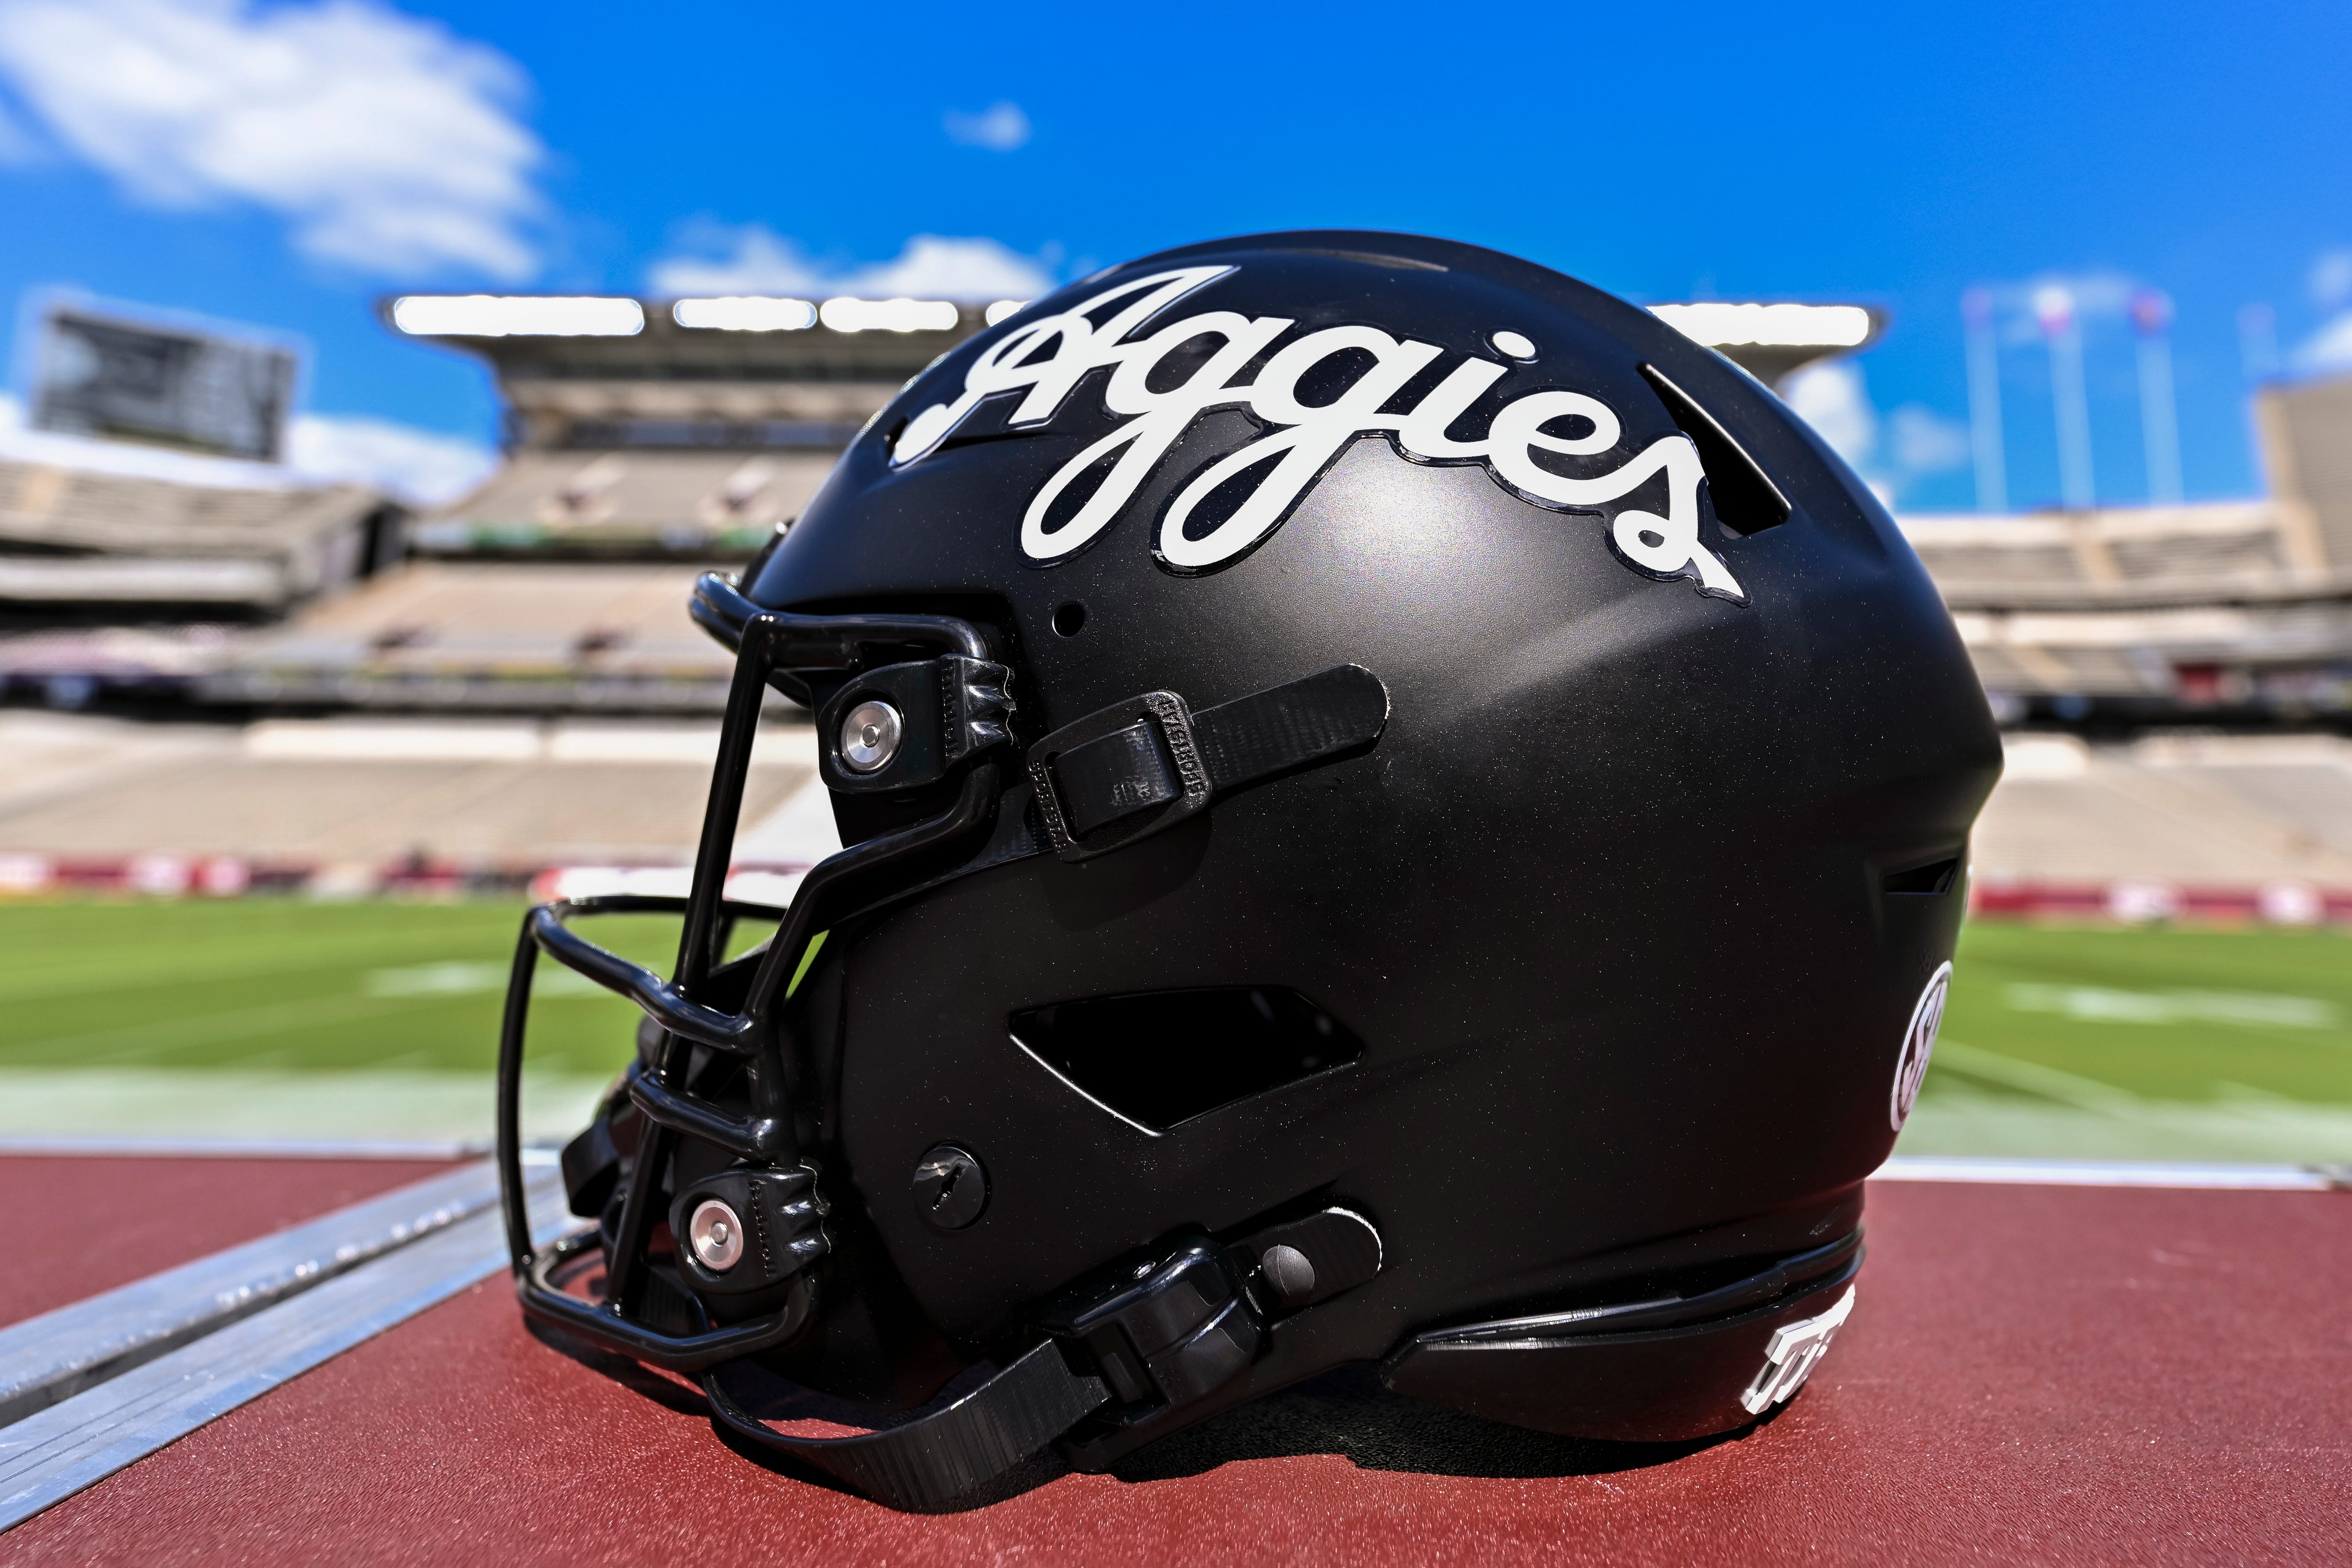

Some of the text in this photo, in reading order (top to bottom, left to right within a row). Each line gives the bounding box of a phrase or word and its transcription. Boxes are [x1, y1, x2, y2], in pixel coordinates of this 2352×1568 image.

[889, 265, 1745, 599] Aggies
[1158, 700, 1206, 796] SPORTSTAR
[1028, 760, 1068, 853] SPORTSTAR
